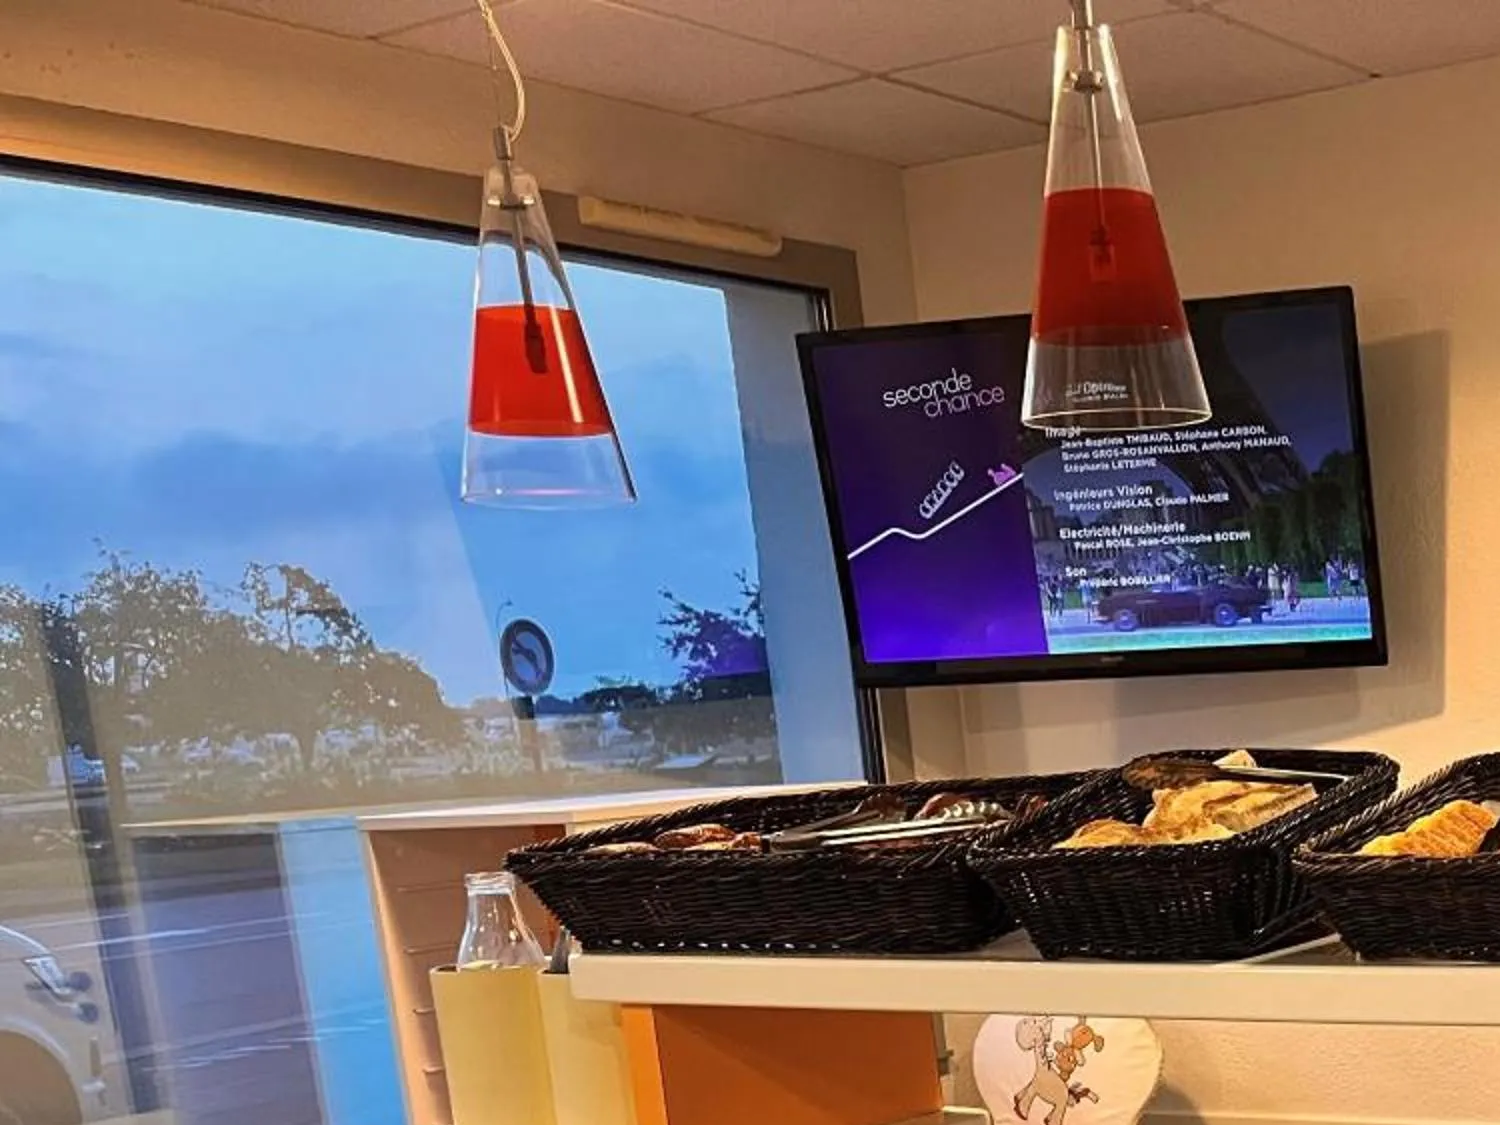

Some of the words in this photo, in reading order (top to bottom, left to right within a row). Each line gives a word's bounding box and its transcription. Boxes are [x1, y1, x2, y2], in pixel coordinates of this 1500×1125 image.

[883, 367, 973, 408] seconde
[923, 386, 1006, 418] chance
[1116, 484, 1154, 496] Vision
[1065, 566, 1087, 577] Son
